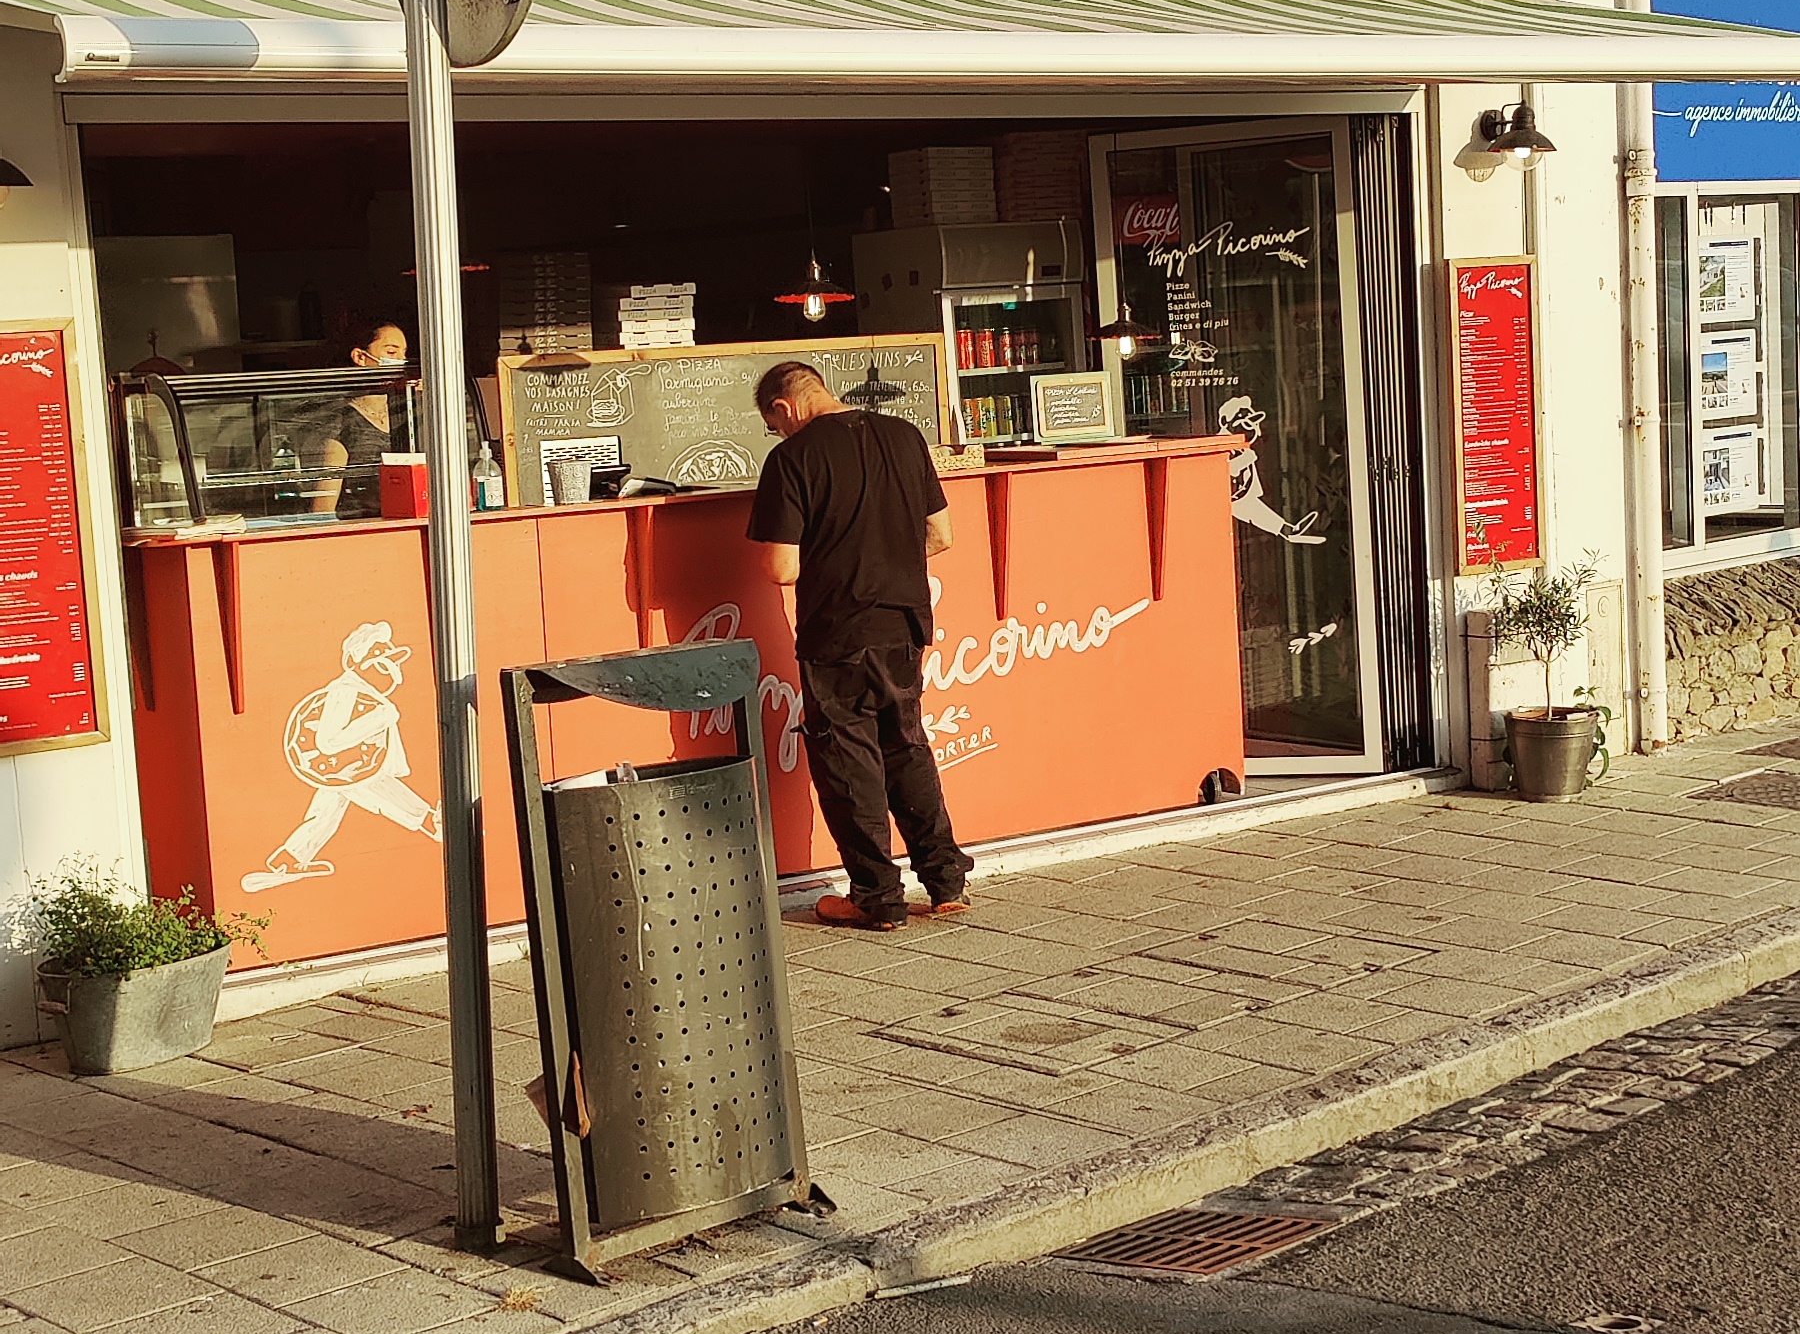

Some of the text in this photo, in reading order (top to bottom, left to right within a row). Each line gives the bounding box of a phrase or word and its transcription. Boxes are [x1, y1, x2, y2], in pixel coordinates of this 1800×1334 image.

[1684, 106, 1734, 138] agence
[1143, 221, 1310, 278] Pizza Picorino
[1167, 291, 1196, 301] Panini
[1167, 300, 1212, 310] Sandwich
[1168, 312, 1200, 321] Burger
[0, 346, 55, 365] corino
[841, 351, 900, 371] LES VINS
[677, 359, 722, 374] PIZZA
[1170, 367, 1224, 377] commandes
[526, 372, 590, 386] COMMANDEZ
[1184, 378, 1196, 386] 51
[1199, 378, 1210, 386] 39
[525, 386, 590, 398] VOS LASAGNES
[922, 576, 1150, 690] icorino
[933, 725, 992, 762] ORTER
